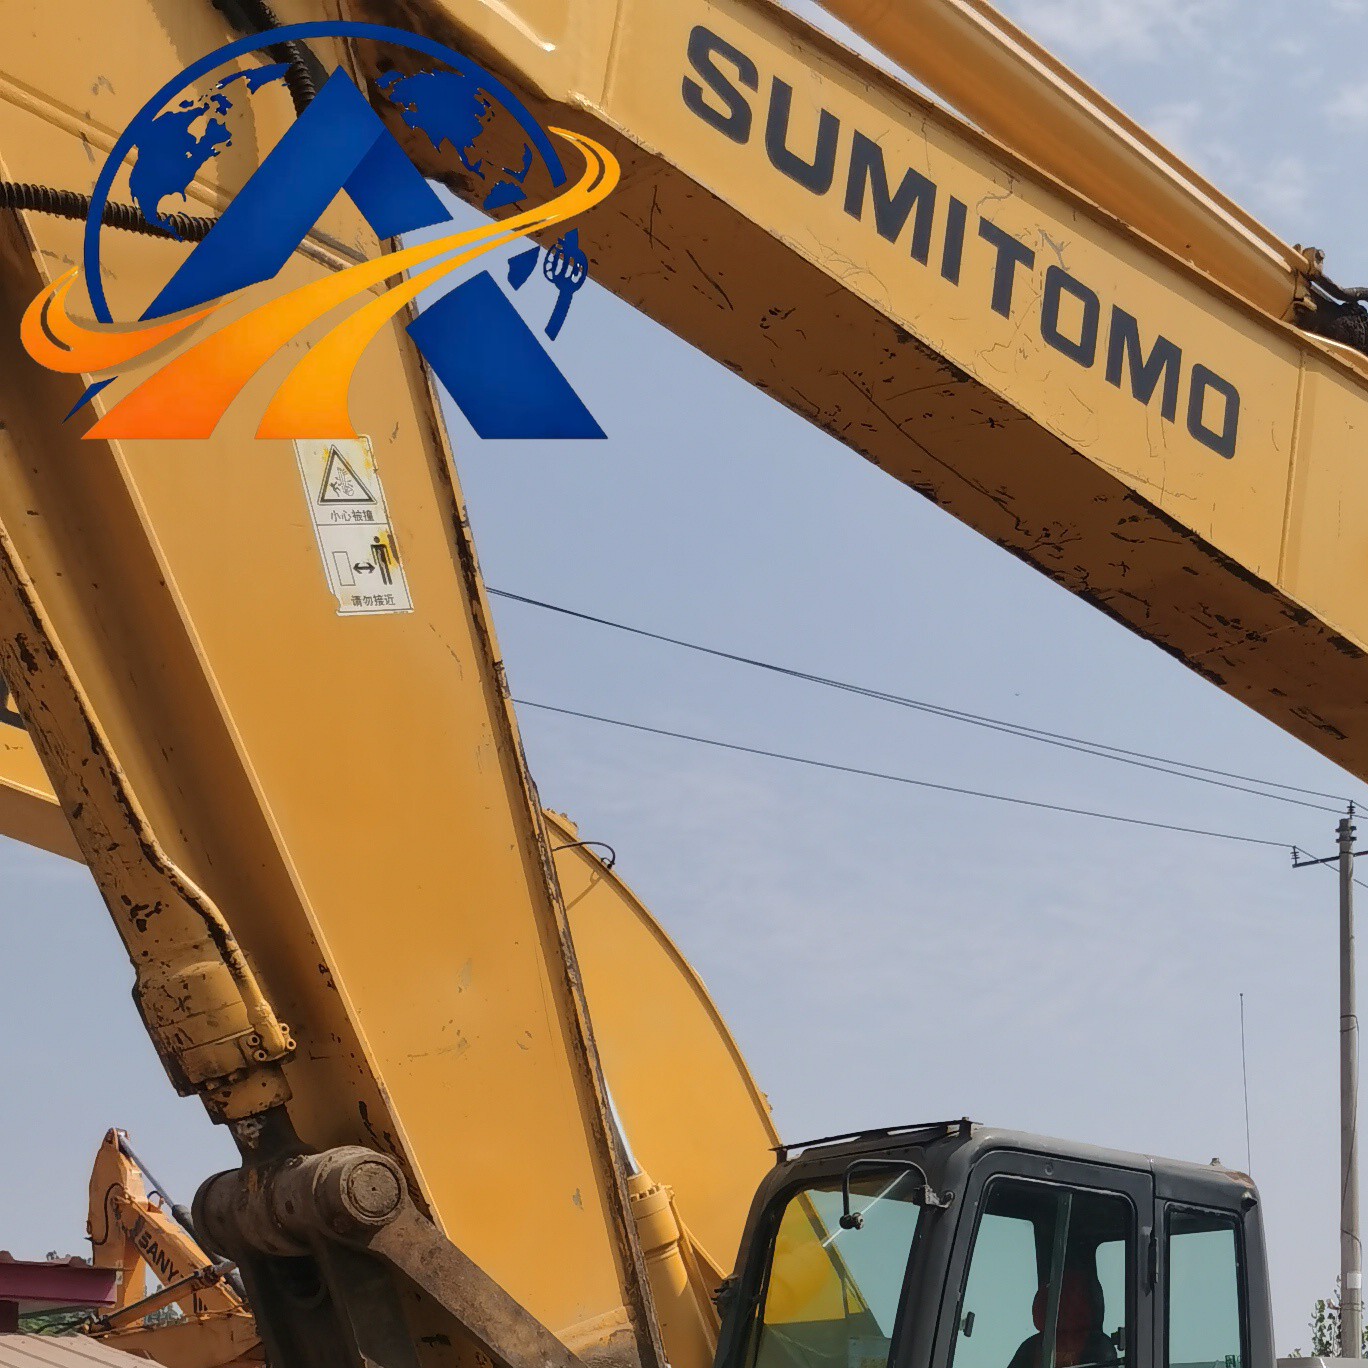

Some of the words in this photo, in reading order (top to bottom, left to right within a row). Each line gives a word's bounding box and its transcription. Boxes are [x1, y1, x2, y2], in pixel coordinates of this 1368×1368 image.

[681, 24, 1241, 460] SUMITOMO
[330, 509, 375, 523] 小心被撞
[350, 593, 396, 607] 请勿接近
[138, 1229, 180, 1283] SANY
